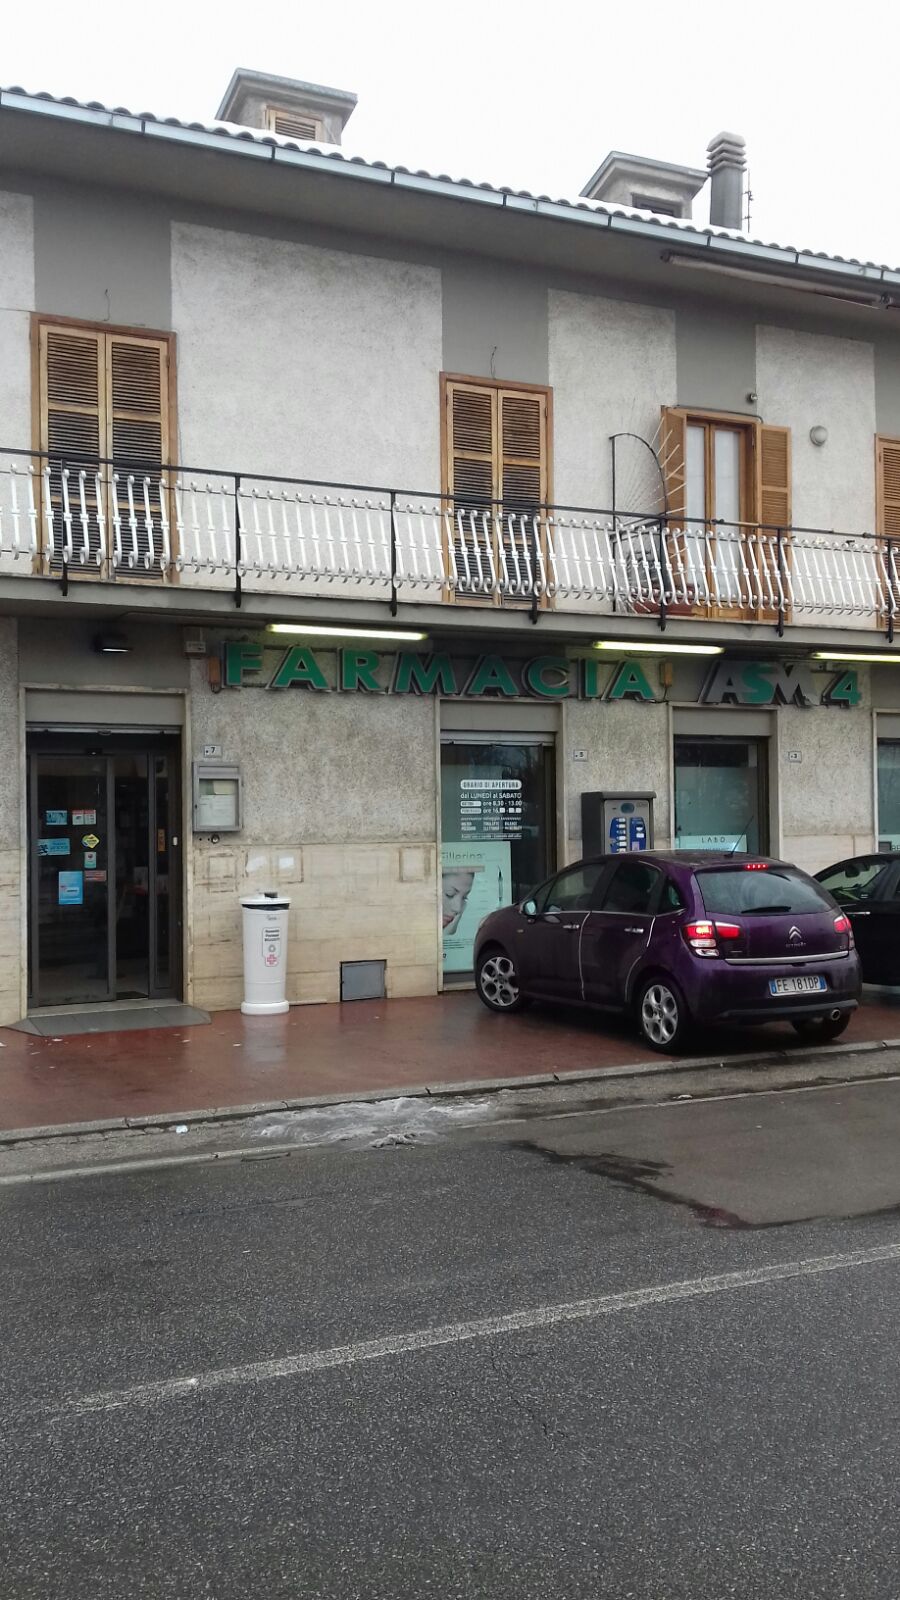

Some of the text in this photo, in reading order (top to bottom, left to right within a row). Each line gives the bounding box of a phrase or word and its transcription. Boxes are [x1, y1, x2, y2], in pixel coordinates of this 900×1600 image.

[223, 643, 862, 708] FARMACIA ASM 4
[776, 976, 819, 992] FE 181DP
